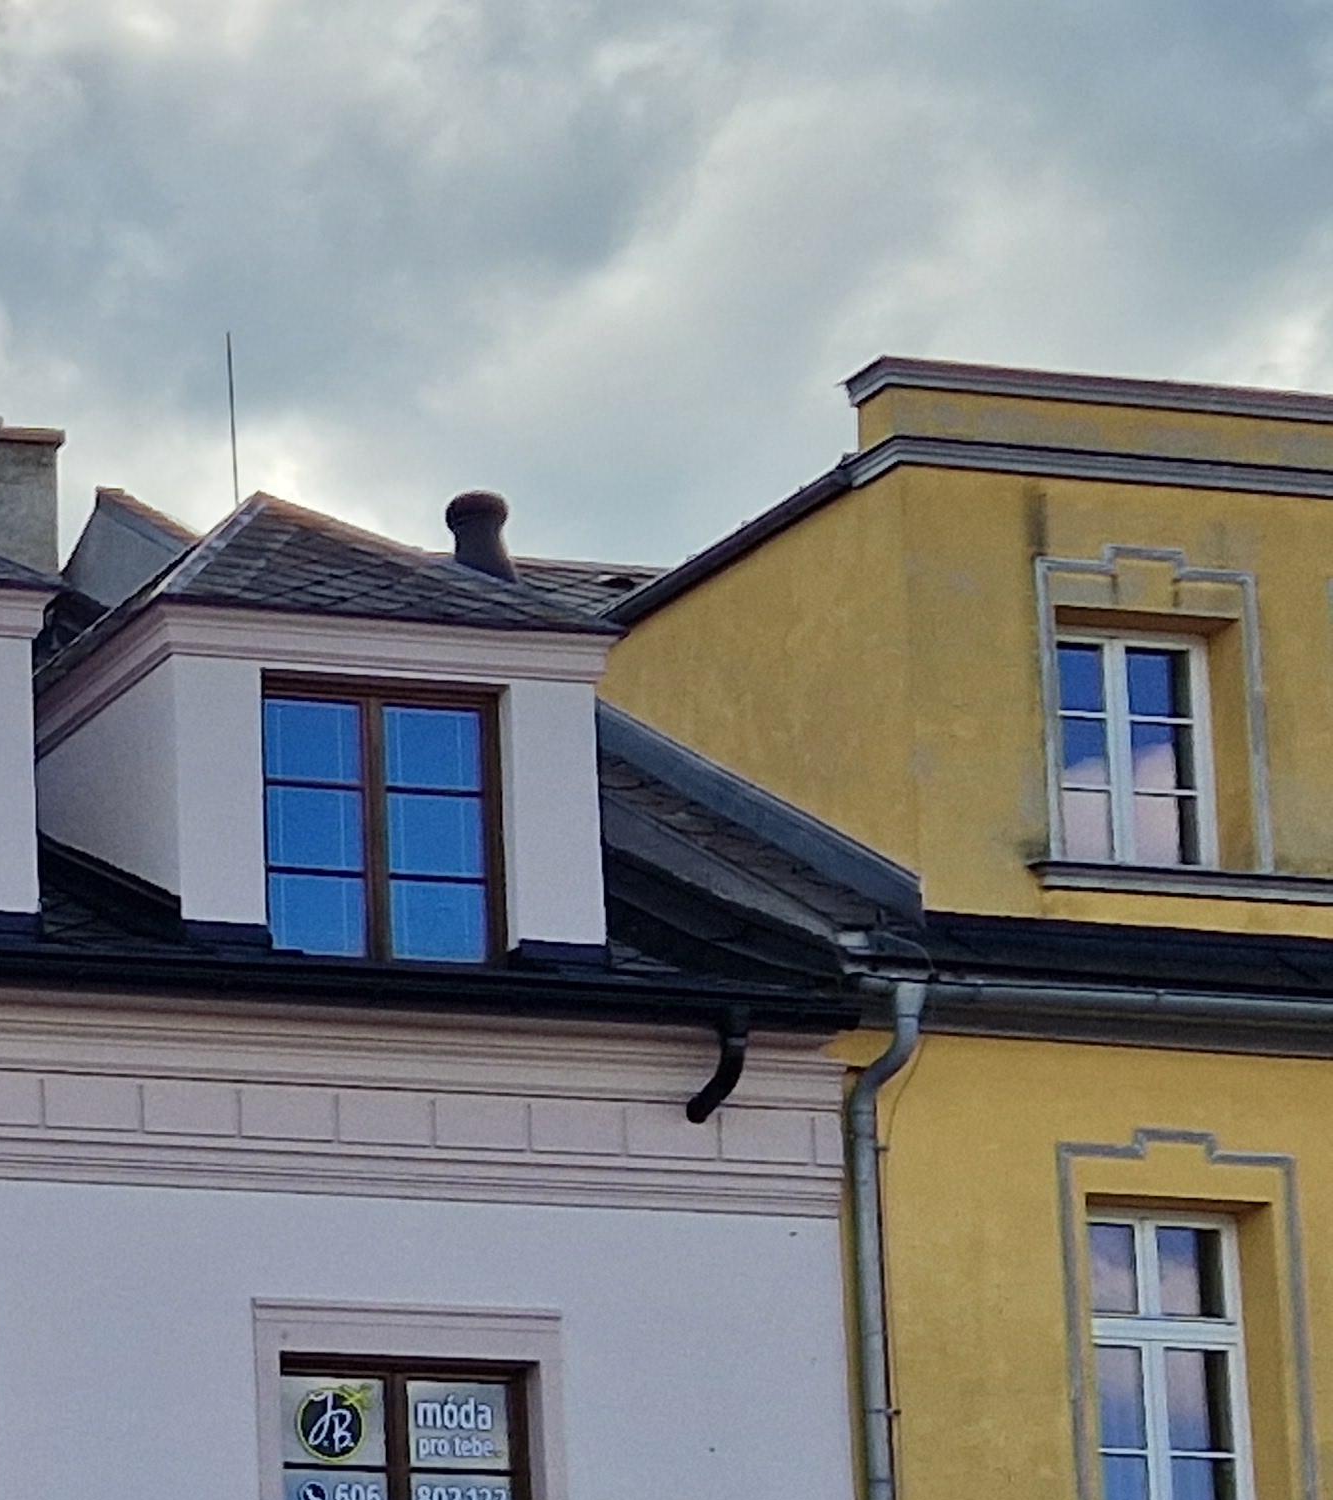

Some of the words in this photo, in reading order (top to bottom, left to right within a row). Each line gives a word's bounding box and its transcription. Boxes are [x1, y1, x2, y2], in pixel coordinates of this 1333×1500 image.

[416, 1393, 494, 1430] móda
[419, 1438, 450, 1460] pro
[454, 1436, 494, 1457] tebe
